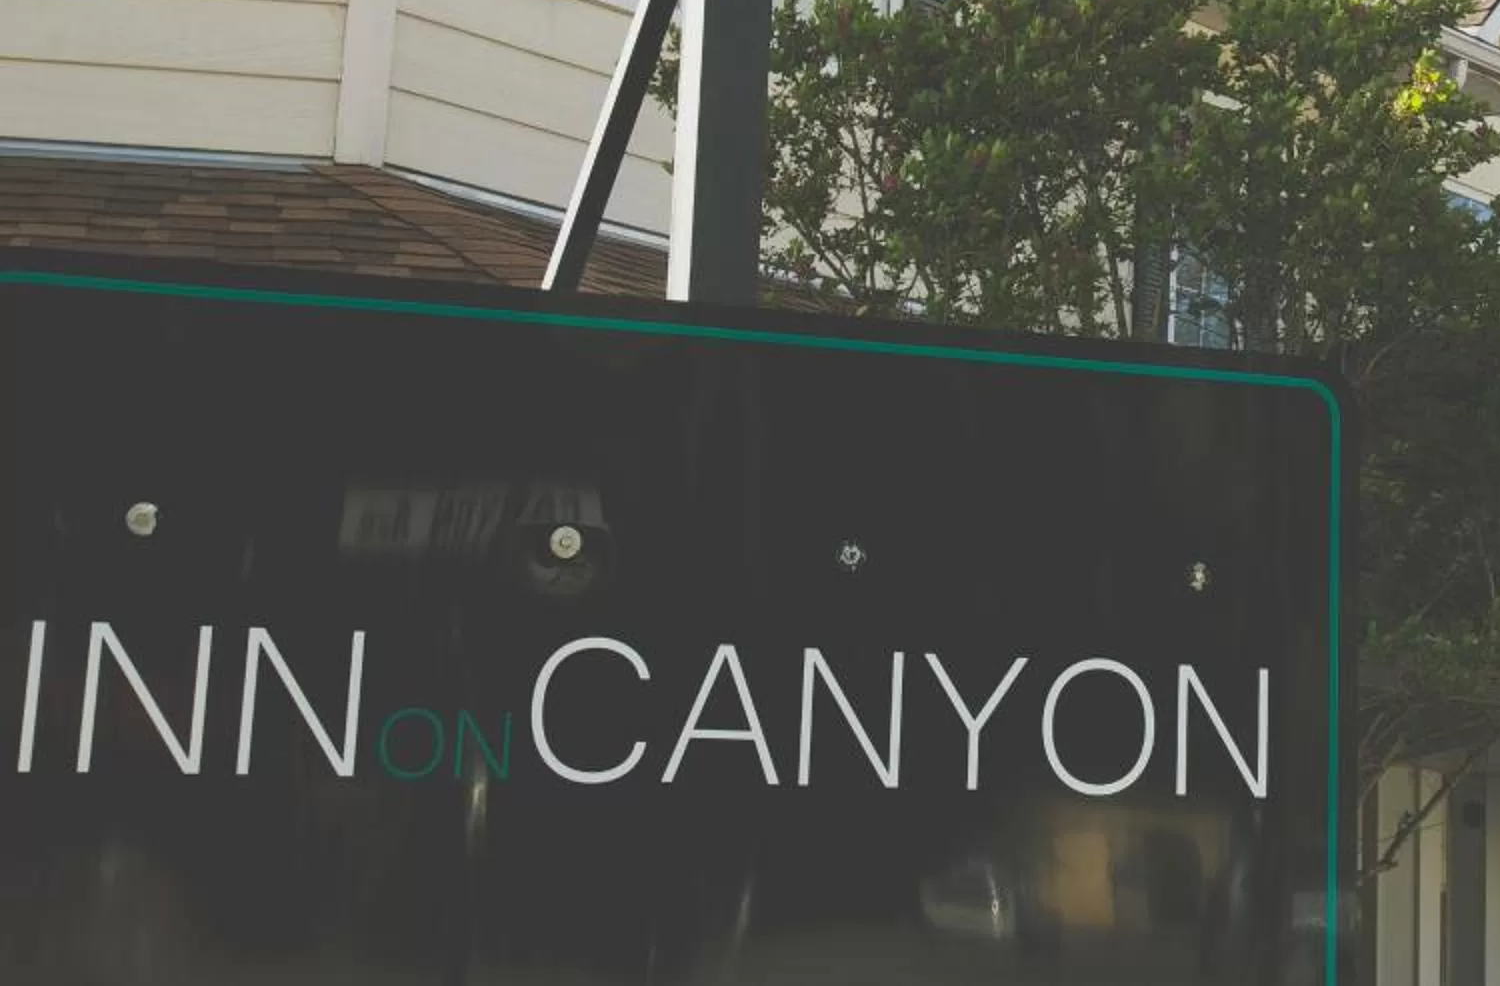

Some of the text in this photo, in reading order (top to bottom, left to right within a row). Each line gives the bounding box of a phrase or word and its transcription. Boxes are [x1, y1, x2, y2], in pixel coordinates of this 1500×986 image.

[17, 620, 1269, 799] INN ON CANYON
